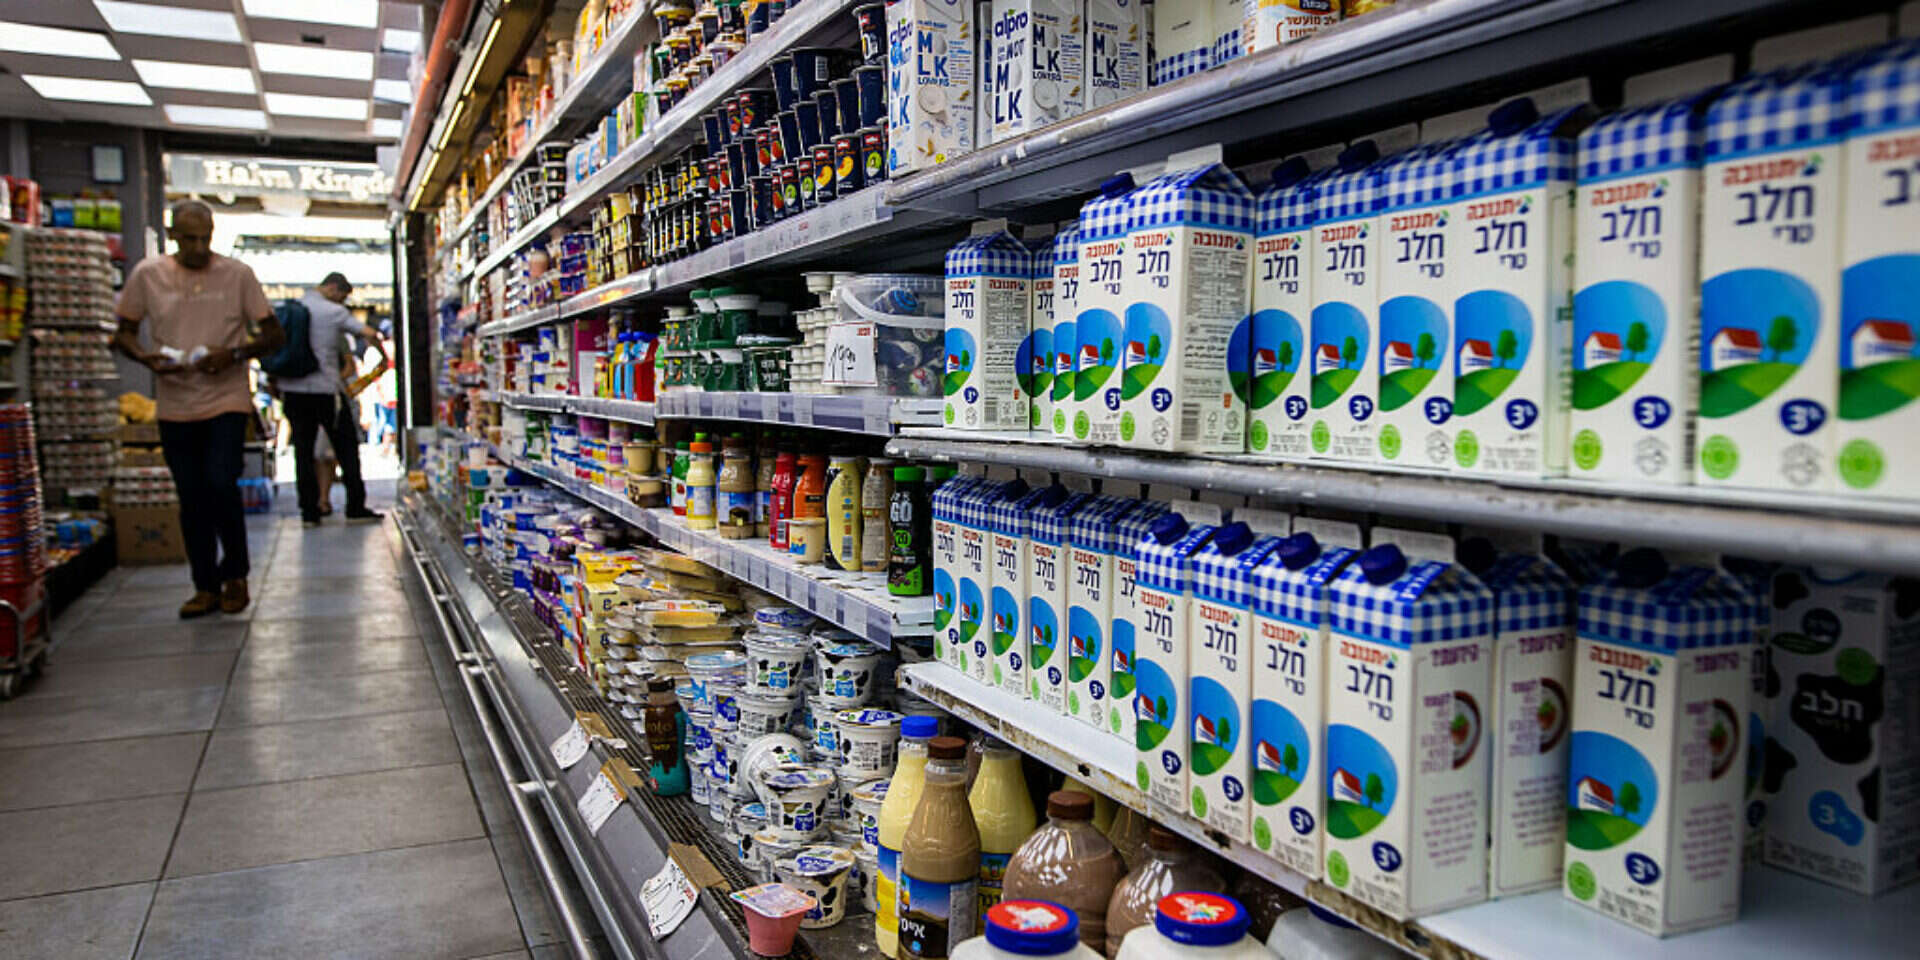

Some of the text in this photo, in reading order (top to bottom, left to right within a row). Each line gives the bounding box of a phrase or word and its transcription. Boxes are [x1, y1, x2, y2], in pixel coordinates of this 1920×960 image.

[995, 11, 1028, 40] alpro
[204, 160, 294, 188] Halva
[1735, 185, 1813, 225] חלב
[1600, 205, 1661, 241] חלב
[1475, 221, 1527, 254] חלב
[1774, 225, 1814, 244] טרי
[1327, 243, 1365, 272] חלב
[1397, 231, 1444, 263] חלב
[1630, 241, 1661, 259] טרי
[1091, 258, 1122, 282] חלב
[1138, 250, 1169, 275] חלב
[1264, 254, 1298, 281] חלב
[1420, 263, 1444, 279] טרי
[1501, 254, 1527, 270] טרי
[1062, 279, 1078, 299] לב
[1104, 282, 1120, 295] טרי
[1152, 276, 1169, 289] טרי
[1280, 280, 1298, 294] טרי
[1345, 272, 1365, 286] טרי
[952, 293, 973, 308] חלב
[961, 309, 973, 319] טרי
[890, 502, 912, 521] GO
[937, 534, 955, 552] חלב
[964, 541, 982, 562] חלב
[945, 553, 955, 564] טרי
[971, 562, 982, 573] טרי
[997, 548, 1016, 570] חלב
[1035, 558, 1055, 580] חלב
[1006, 570, 1016, 582] טרי
[1043, 580, 1055, 591] טרי
[1077, 564, 1100, 589] חלב
[1121, 575, 1135, 597] לב
[1087, 588, 1100, 602] טרי
[1145, 609, 1172, 637] חלב
[1156, 638, 1172, 653] טרי
[1204, 624, 1236, 655] חלב
[1220, 655, 1236, 672] טרי
[1267, 644, 1305, 677] חלב
[1285, 677, 1305, 695] טרי
[1347, 664, 1393, 702] חלב
[1598, 667, 1655, 709] חלב
[1368, 700, 1393, 721] טרי
[1799, 688, 1863, 721] חלב
[1624, 708, 1655, 729] טרי
